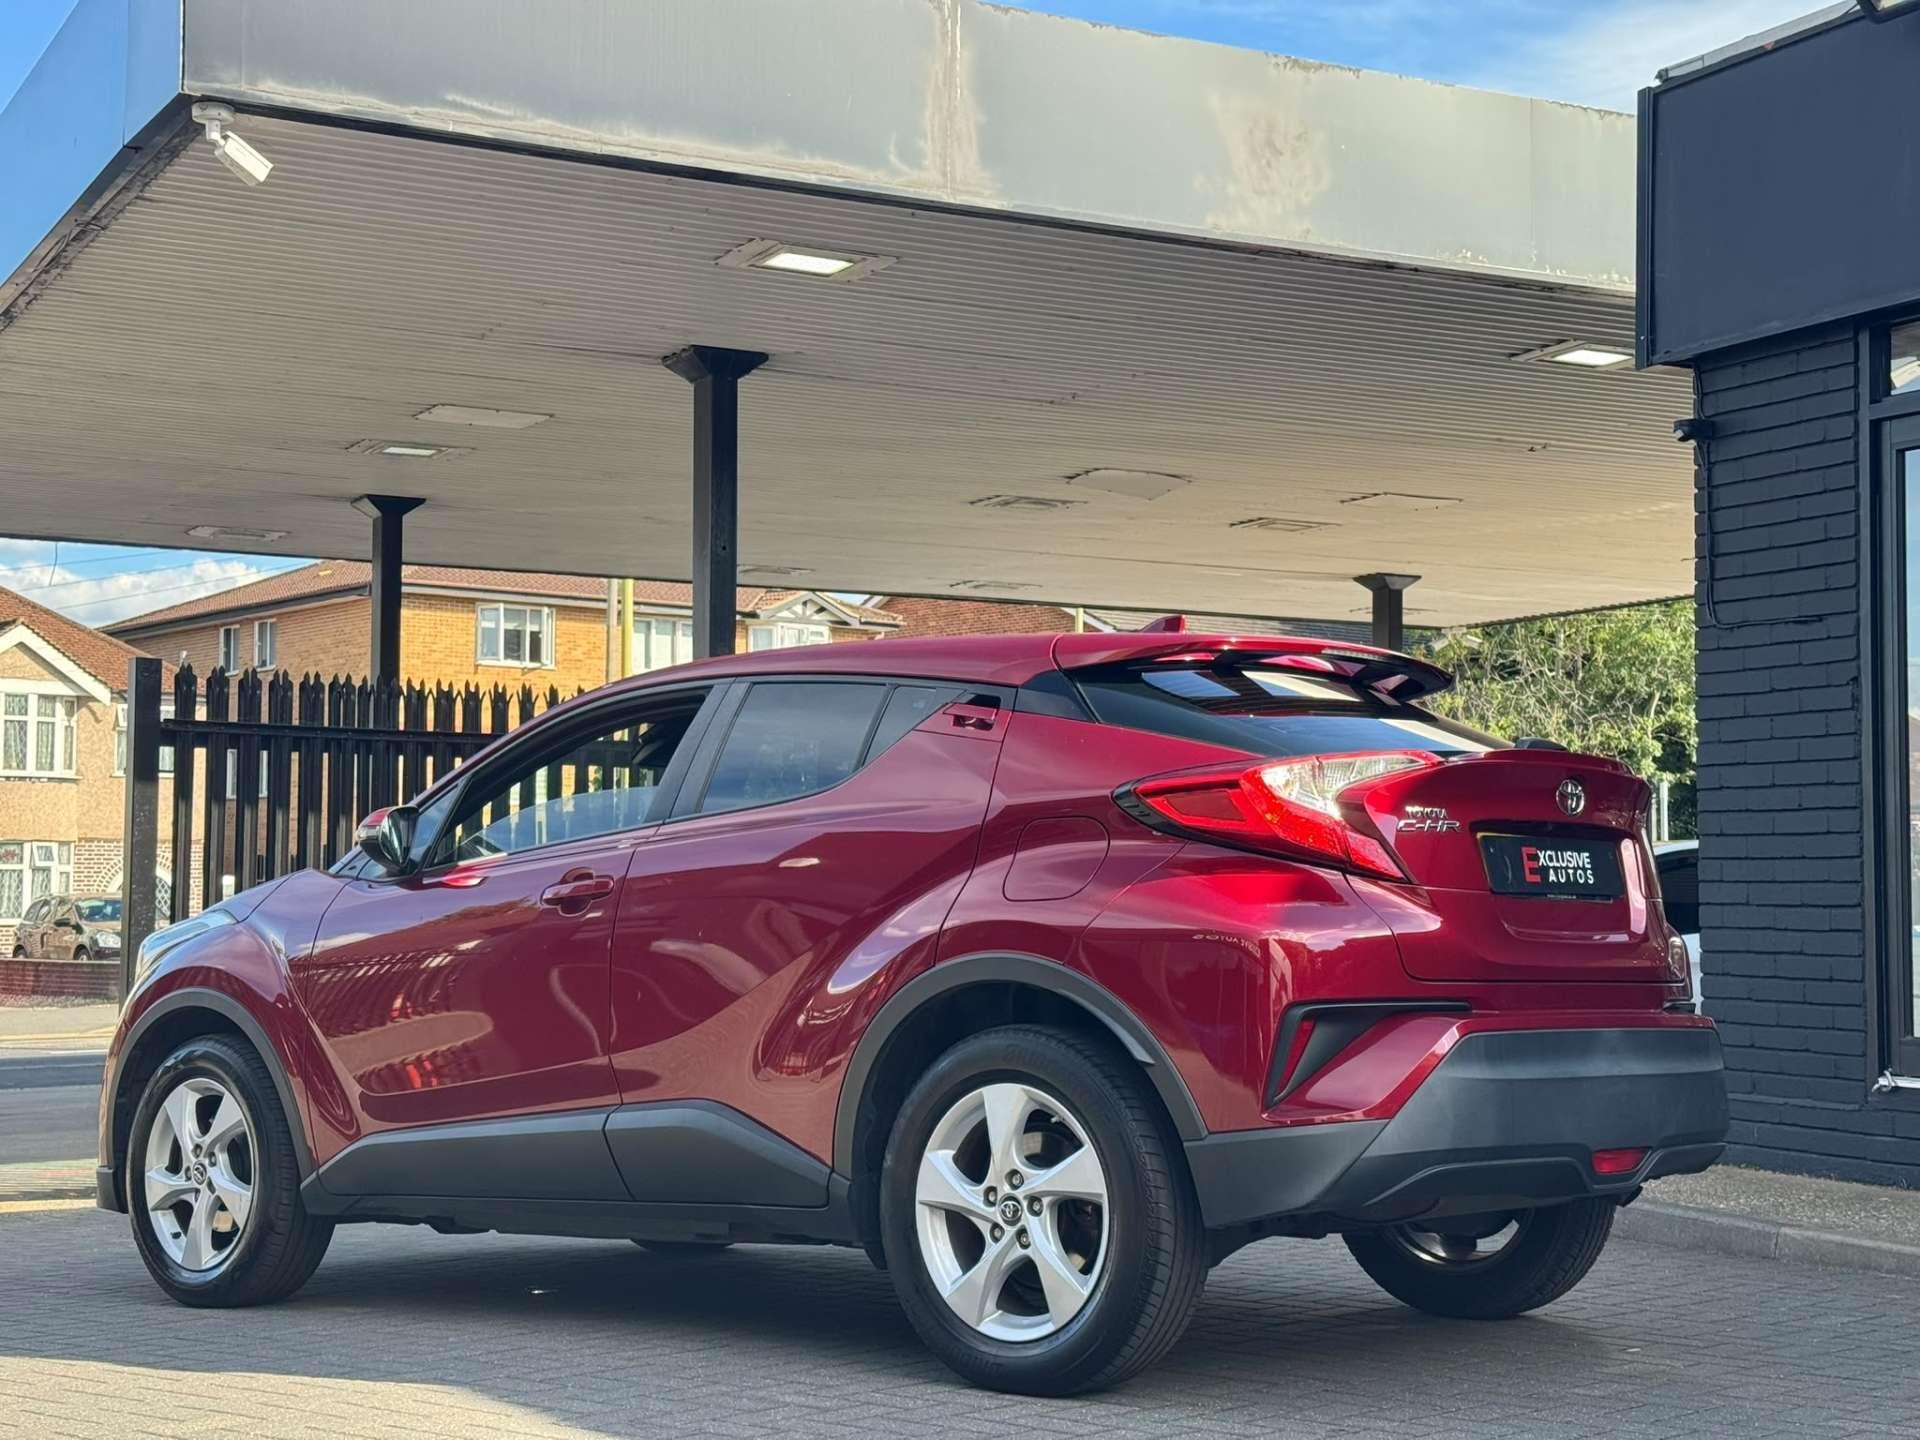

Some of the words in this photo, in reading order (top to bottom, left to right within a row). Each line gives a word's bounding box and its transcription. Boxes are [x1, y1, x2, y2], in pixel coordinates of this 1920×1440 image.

[1405, 805, 1448, 819] TOYOTA
[1397, 819, 1460, 832] C-HR
[1521, 846, 1592, 883] EXCLUSIVE
[1549, 868, 1594, 884] AUTOS
